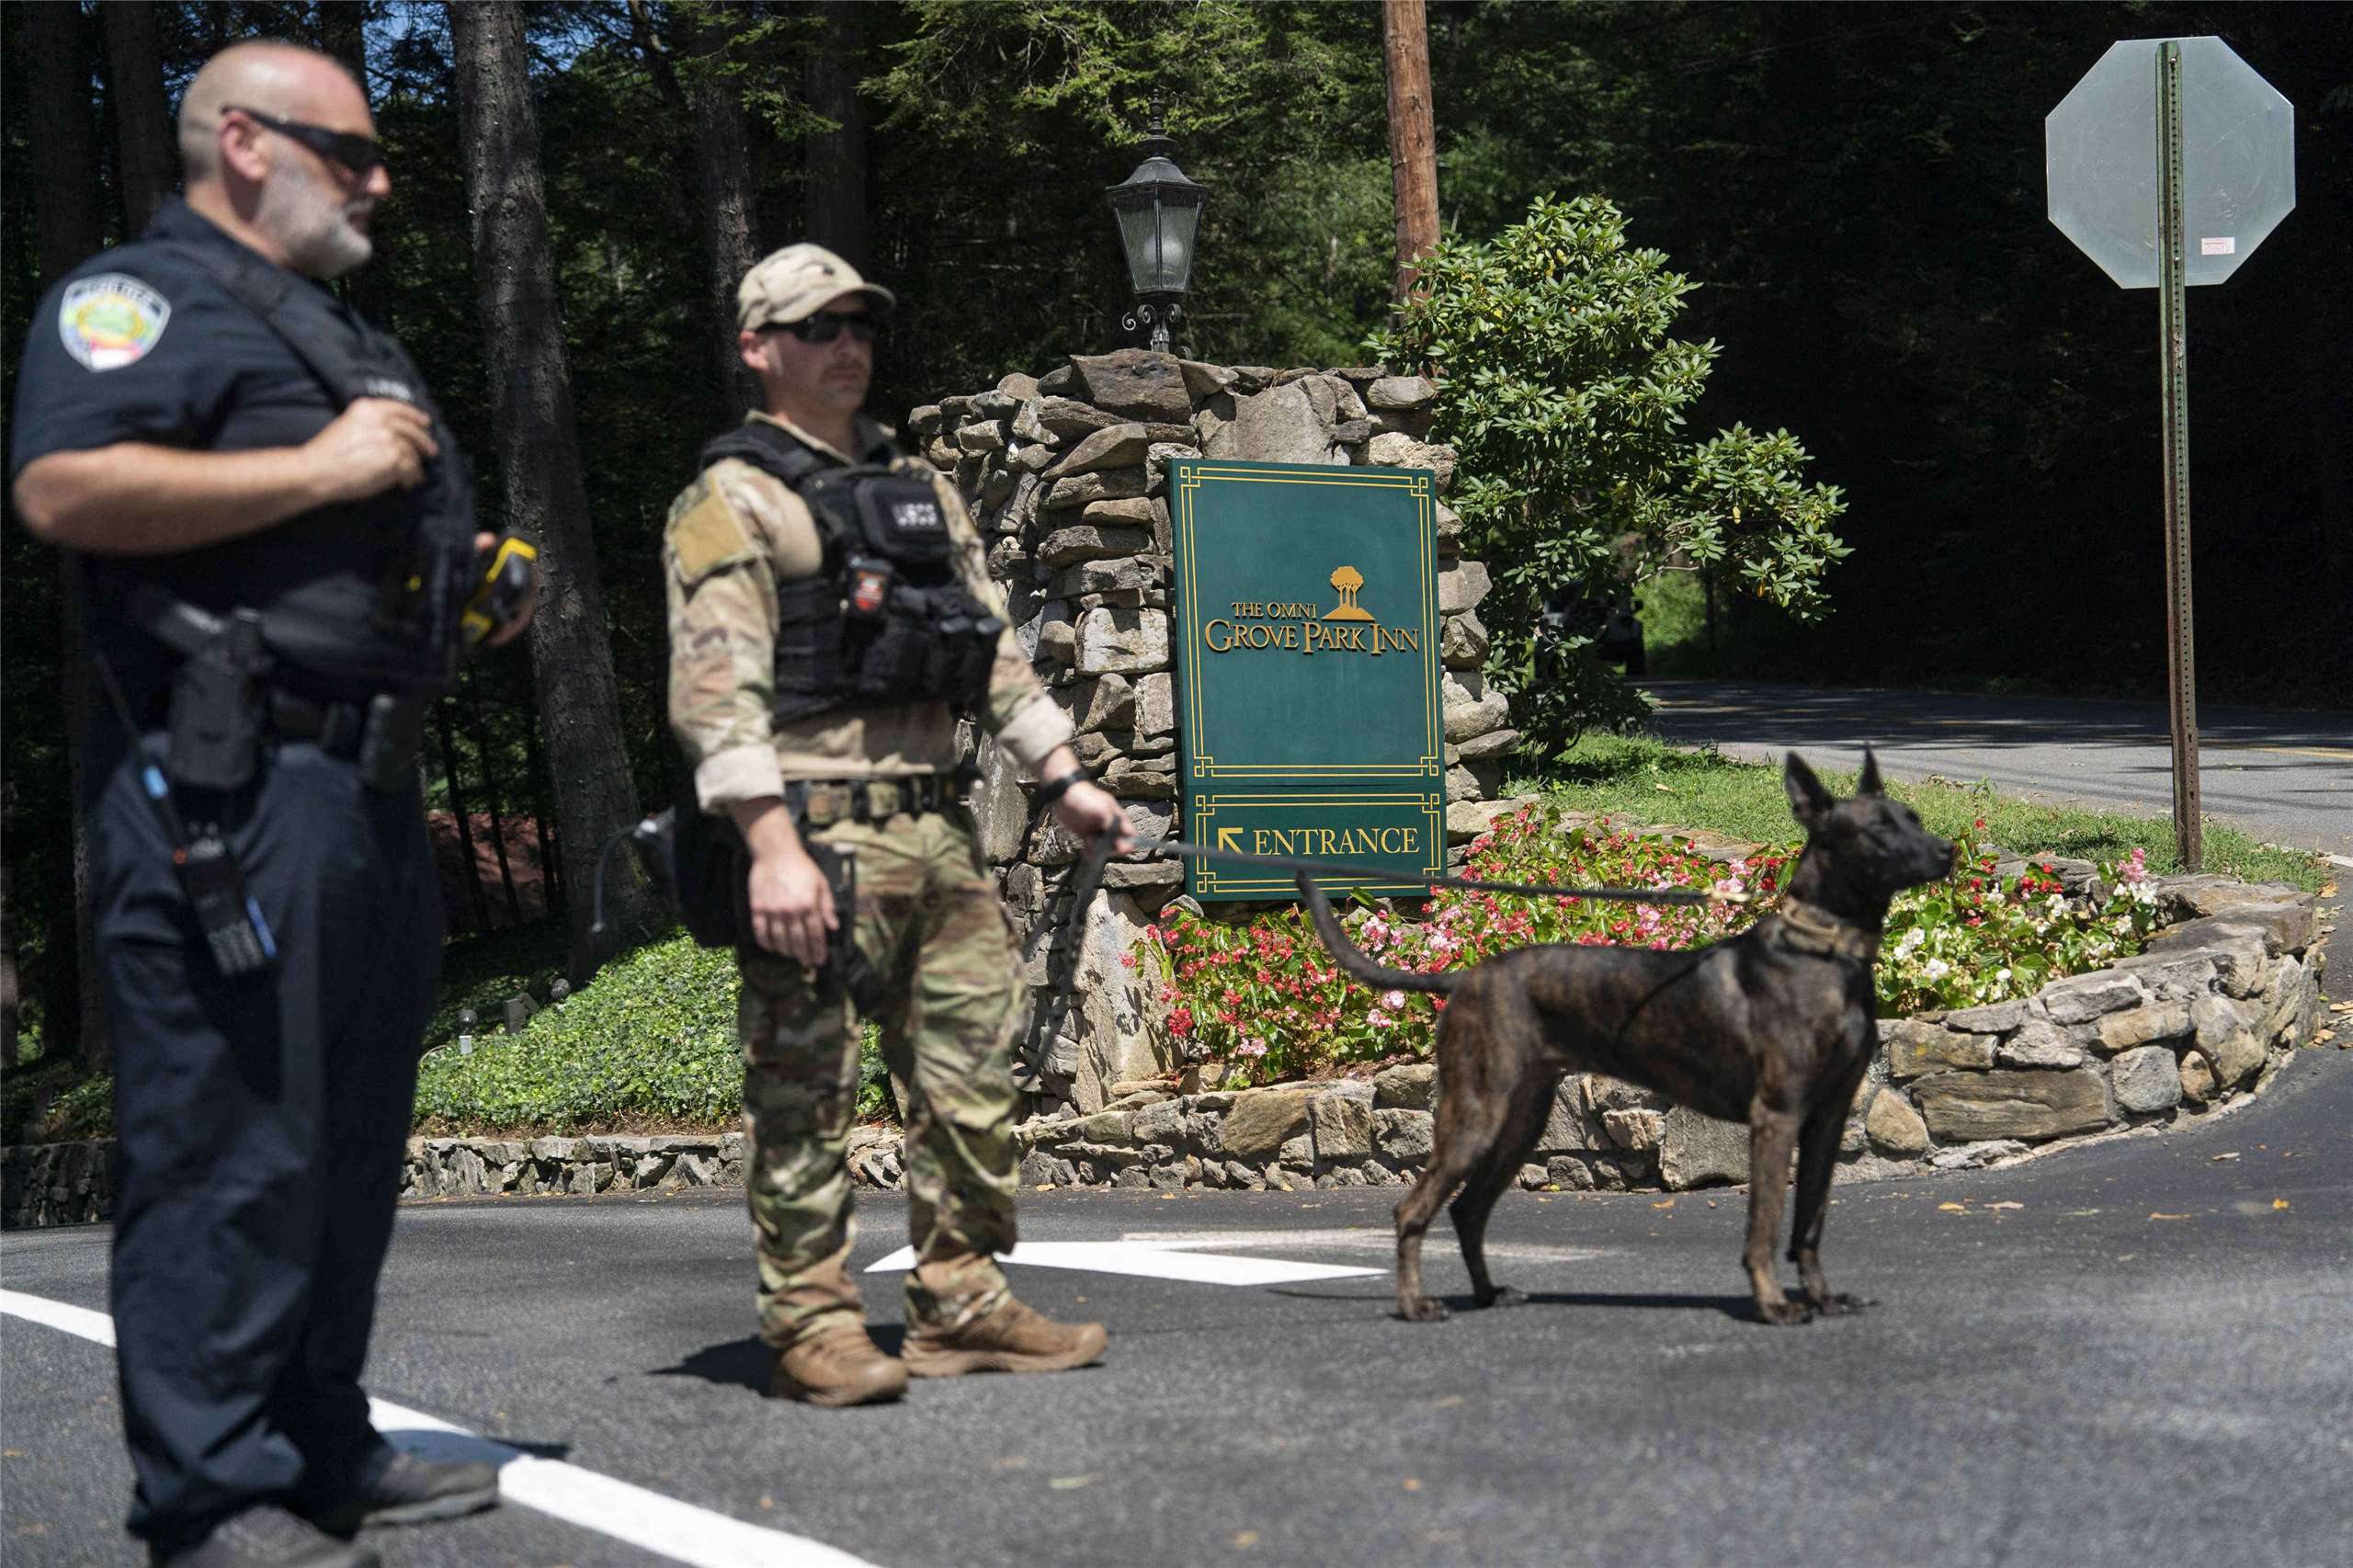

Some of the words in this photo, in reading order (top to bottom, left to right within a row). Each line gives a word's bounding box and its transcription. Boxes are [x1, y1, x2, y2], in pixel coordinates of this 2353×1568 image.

[1232, 602, 1264, 618] THE
[1267, 602, 1317, 619] OMNI
[1205, 619, 1300, 652] GROVE
[1302, 621, 1367, 654] PARK
[1370, 623, 1420, 656] INN
[1253, 827, 1420, 856] ENTRANCE
